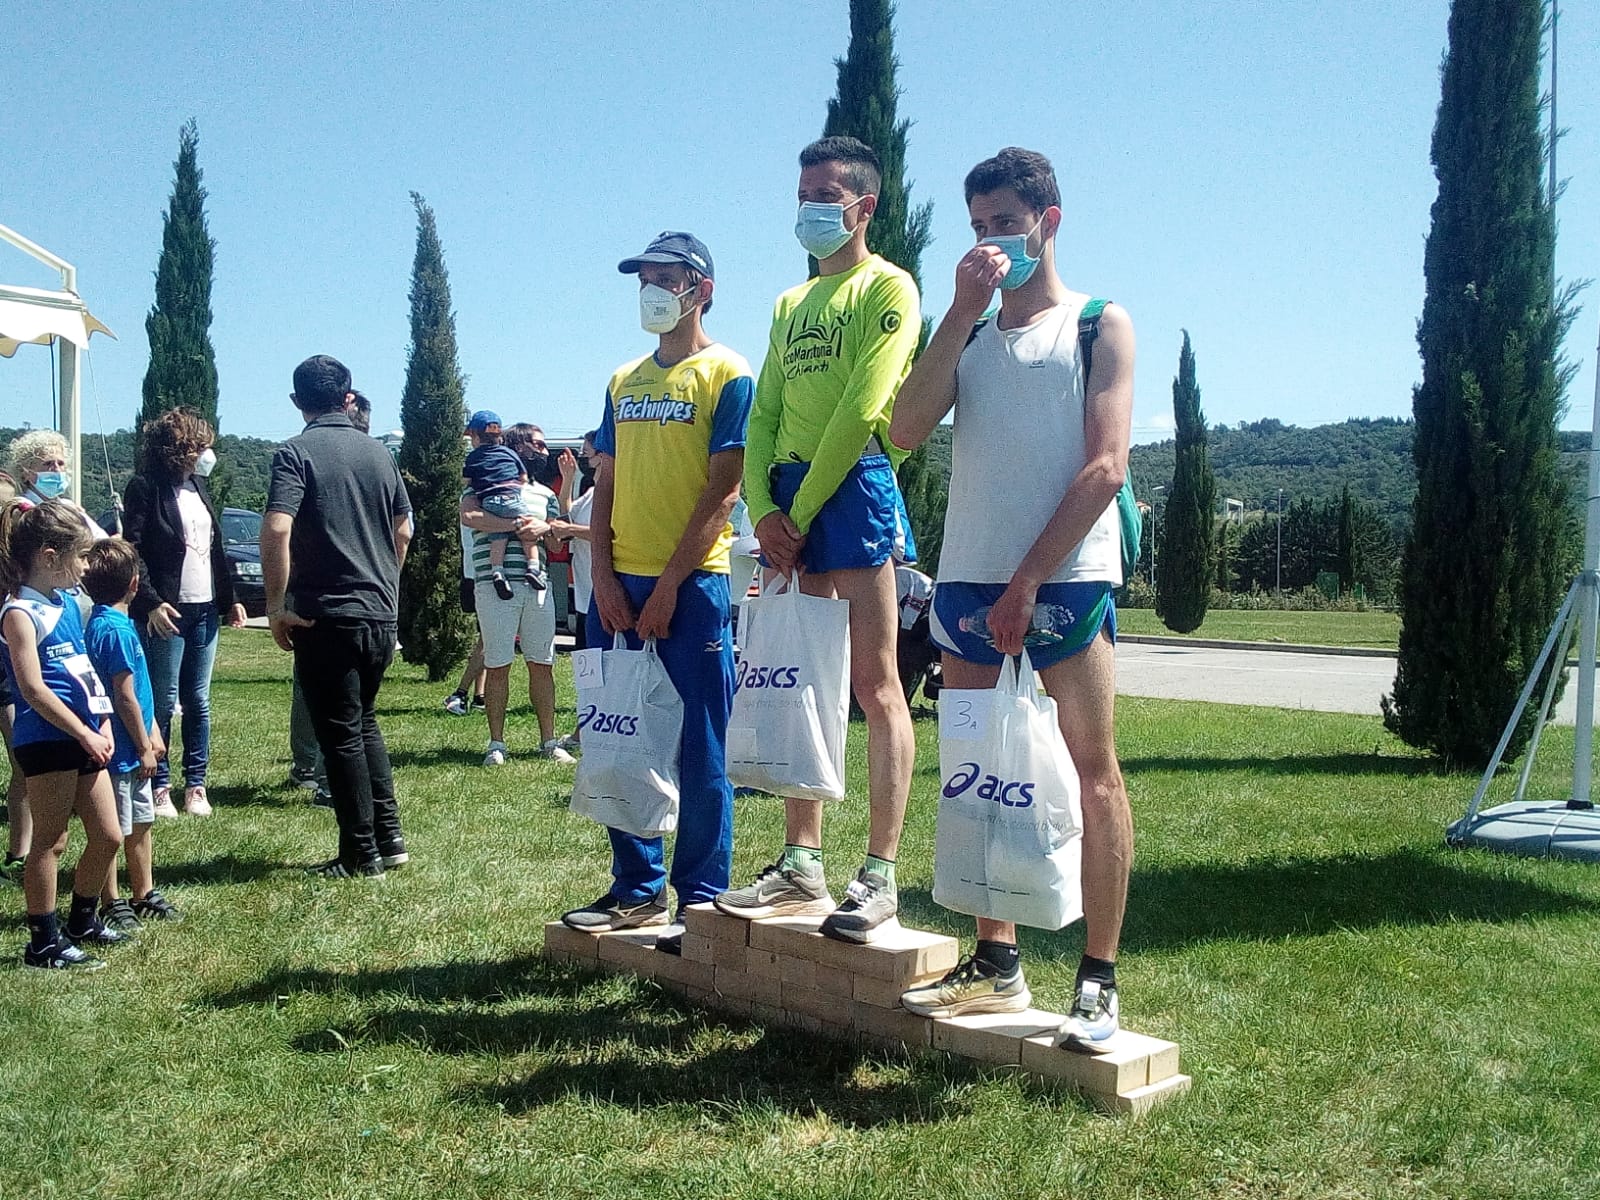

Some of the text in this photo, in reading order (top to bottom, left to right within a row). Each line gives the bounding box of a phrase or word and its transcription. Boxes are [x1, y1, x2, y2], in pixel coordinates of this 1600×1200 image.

[617, 394, 695, 425] Technipes
[745, 666, 800, 689] asics
[592, 712, 639, 736] asics
